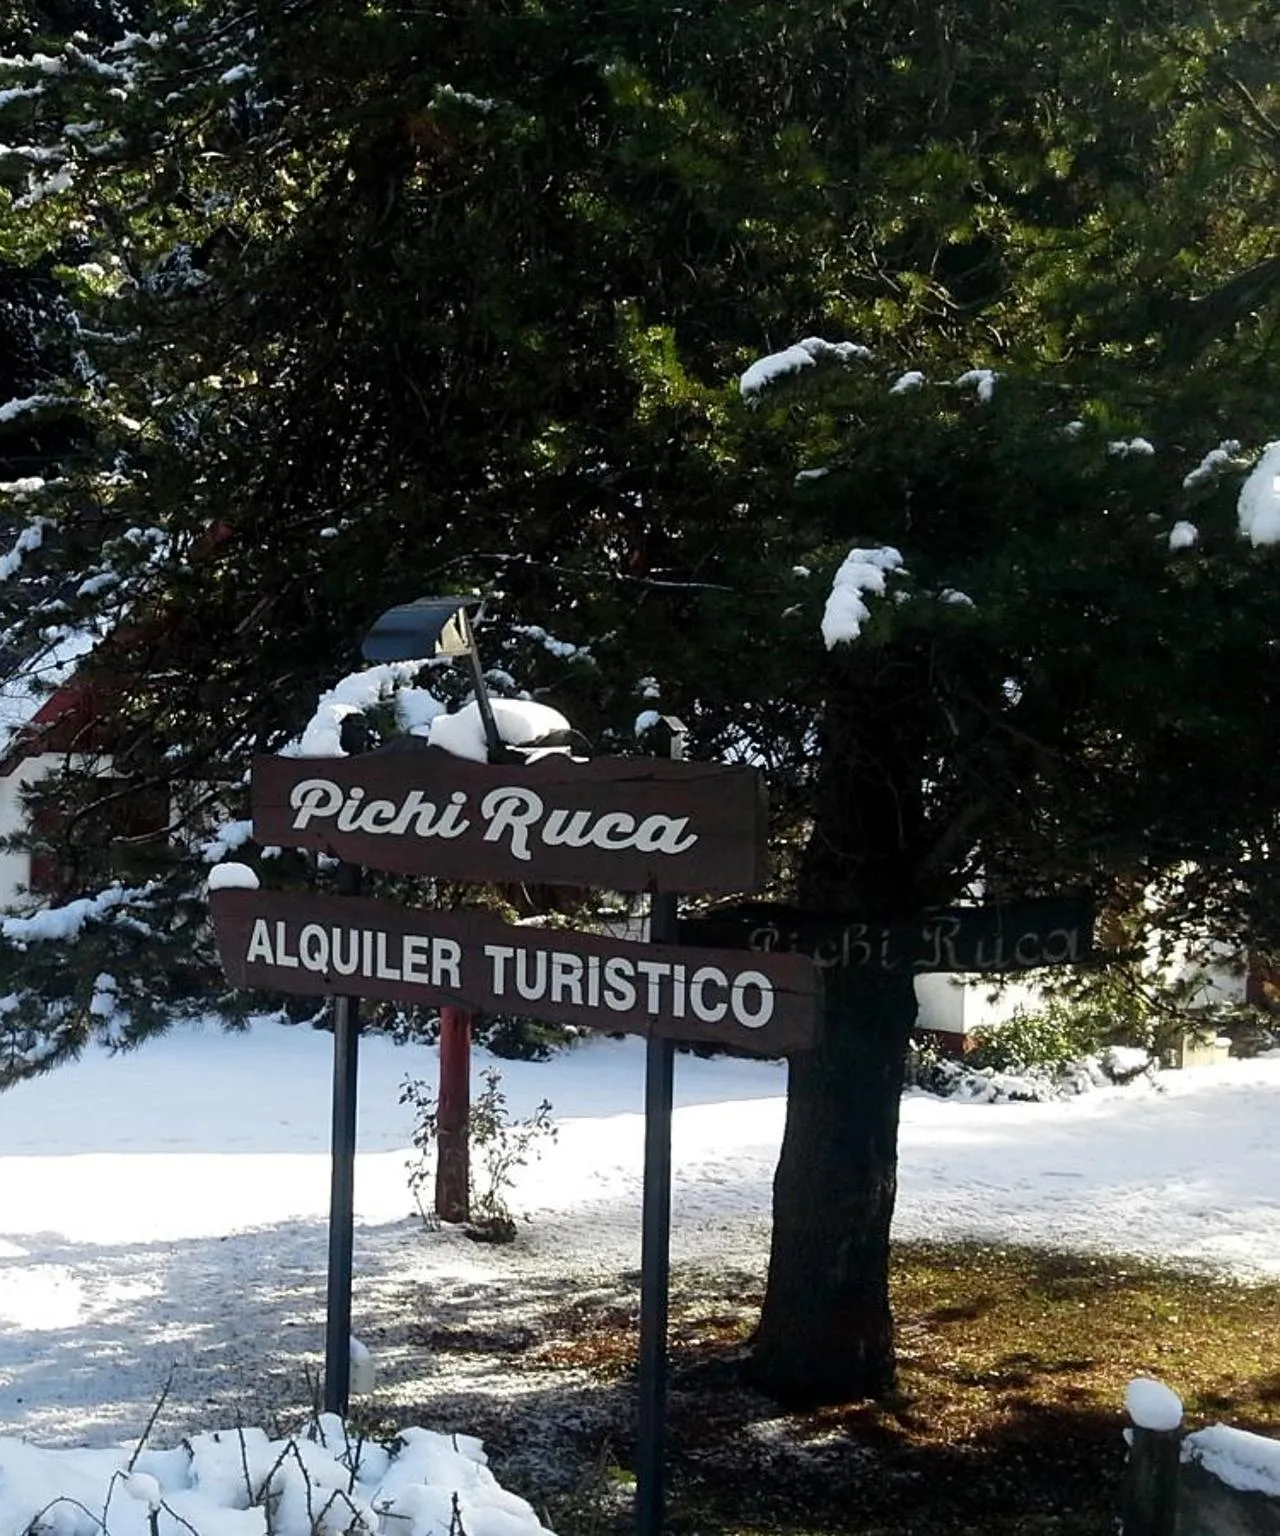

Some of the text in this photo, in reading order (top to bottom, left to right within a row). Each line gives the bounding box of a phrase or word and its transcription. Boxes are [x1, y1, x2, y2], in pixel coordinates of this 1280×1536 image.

[288, 778, 699, 861] Pichi Ruca
[246, 917, 775, 1029] ALQUILER TURISTICO
[913, 909, 1080, 968] Ruca
